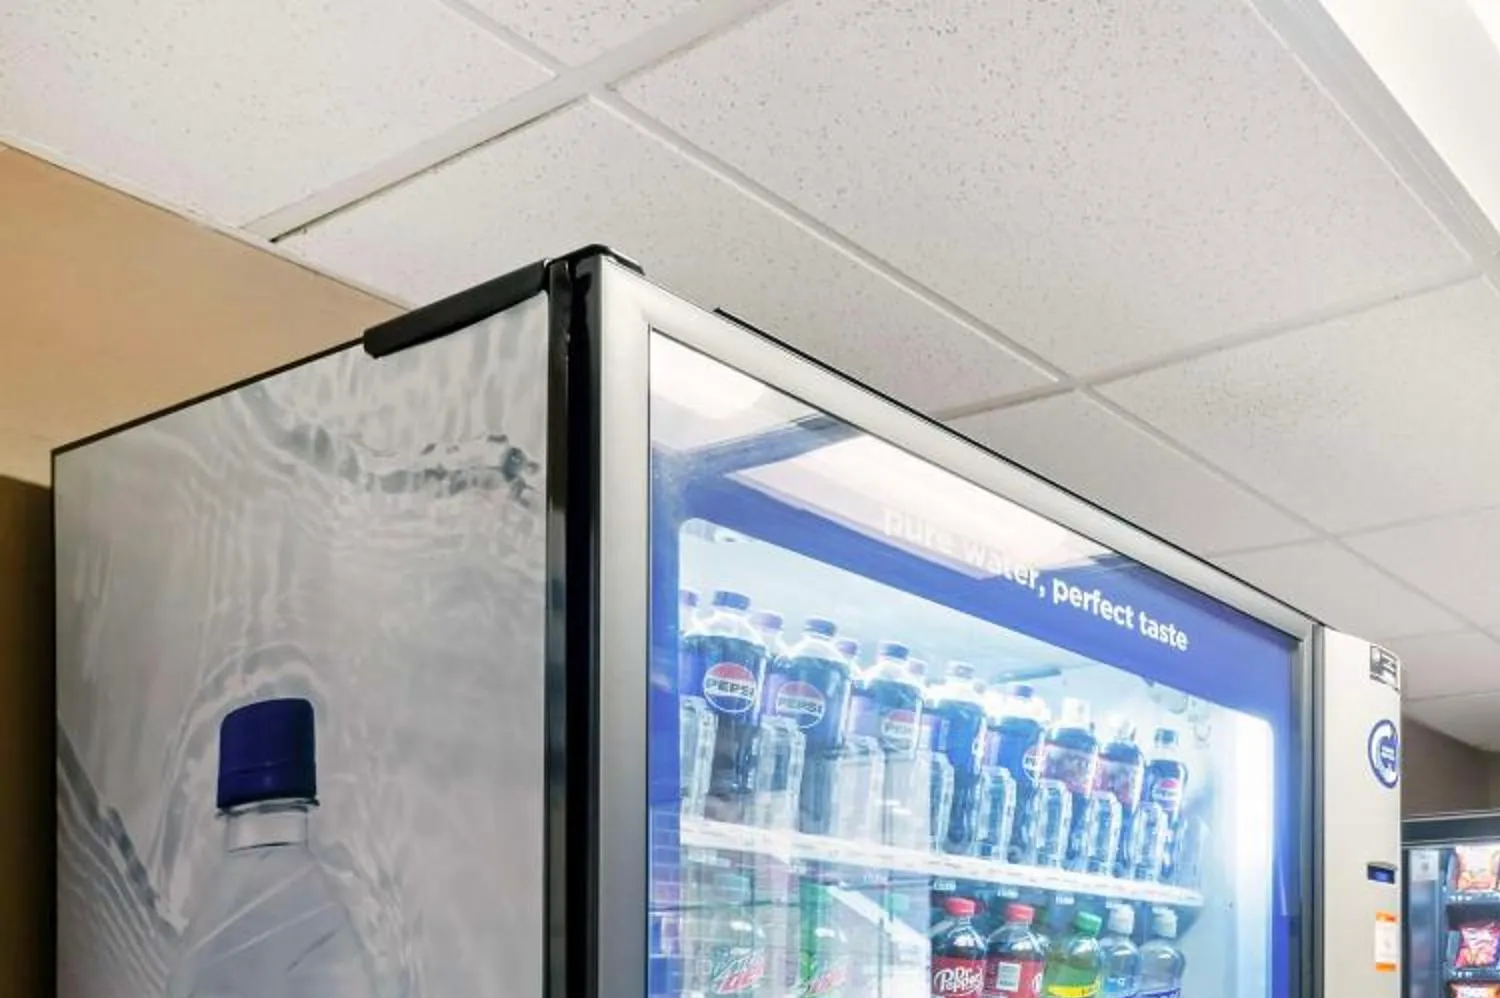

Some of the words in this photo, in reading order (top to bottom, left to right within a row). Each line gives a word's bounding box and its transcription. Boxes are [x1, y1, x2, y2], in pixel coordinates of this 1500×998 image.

[963, 539, 1047, 599] water,
[1053, 577, 1134, 631] perfect
[1138, 610, 1189, 653] taste
[705, 678, 755, 700] PEPSI
